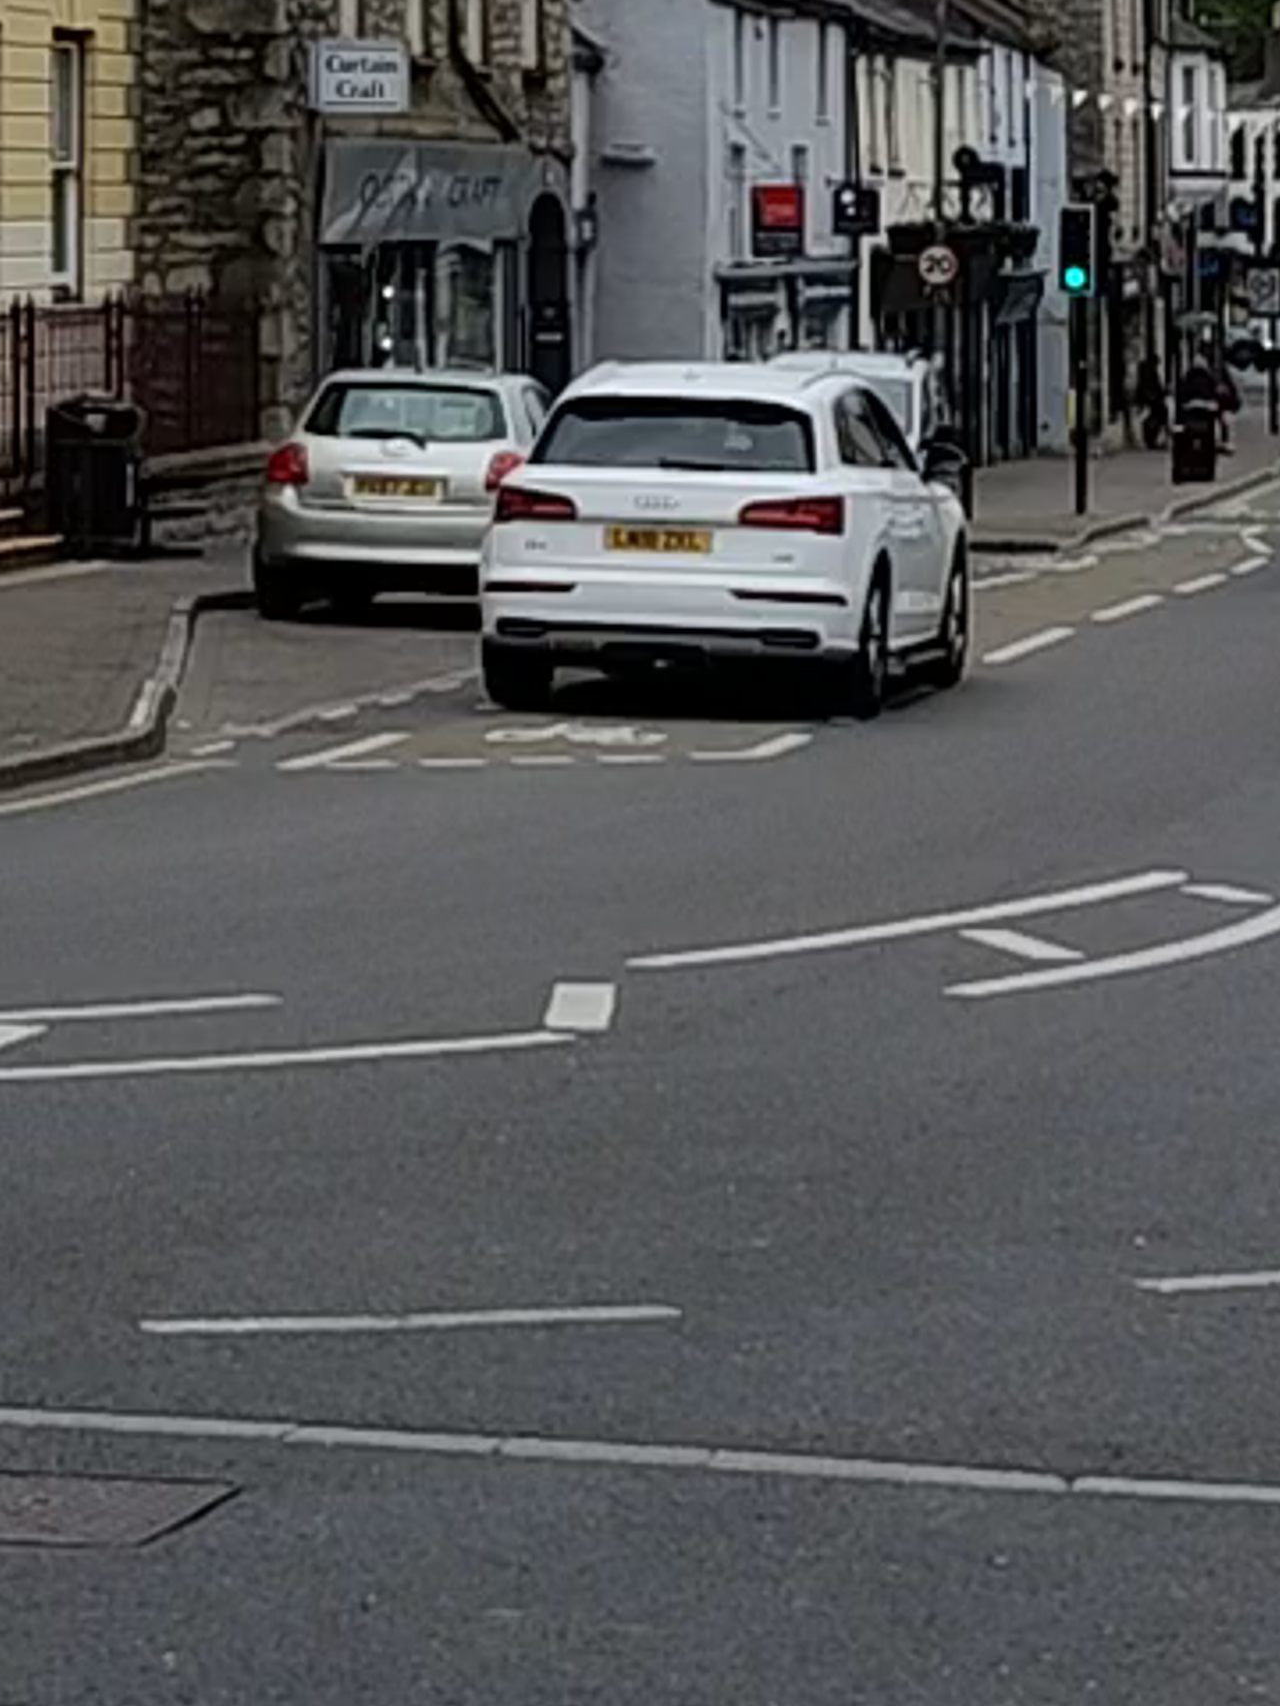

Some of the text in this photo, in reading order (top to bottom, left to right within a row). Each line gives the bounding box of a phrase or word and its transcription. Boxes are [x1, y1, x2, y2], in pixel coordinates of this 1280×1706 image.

[325, 53, 398, 74] Curtain
[335, 80, 384, 99] Craft
[923, 254, 951, 275] 20
